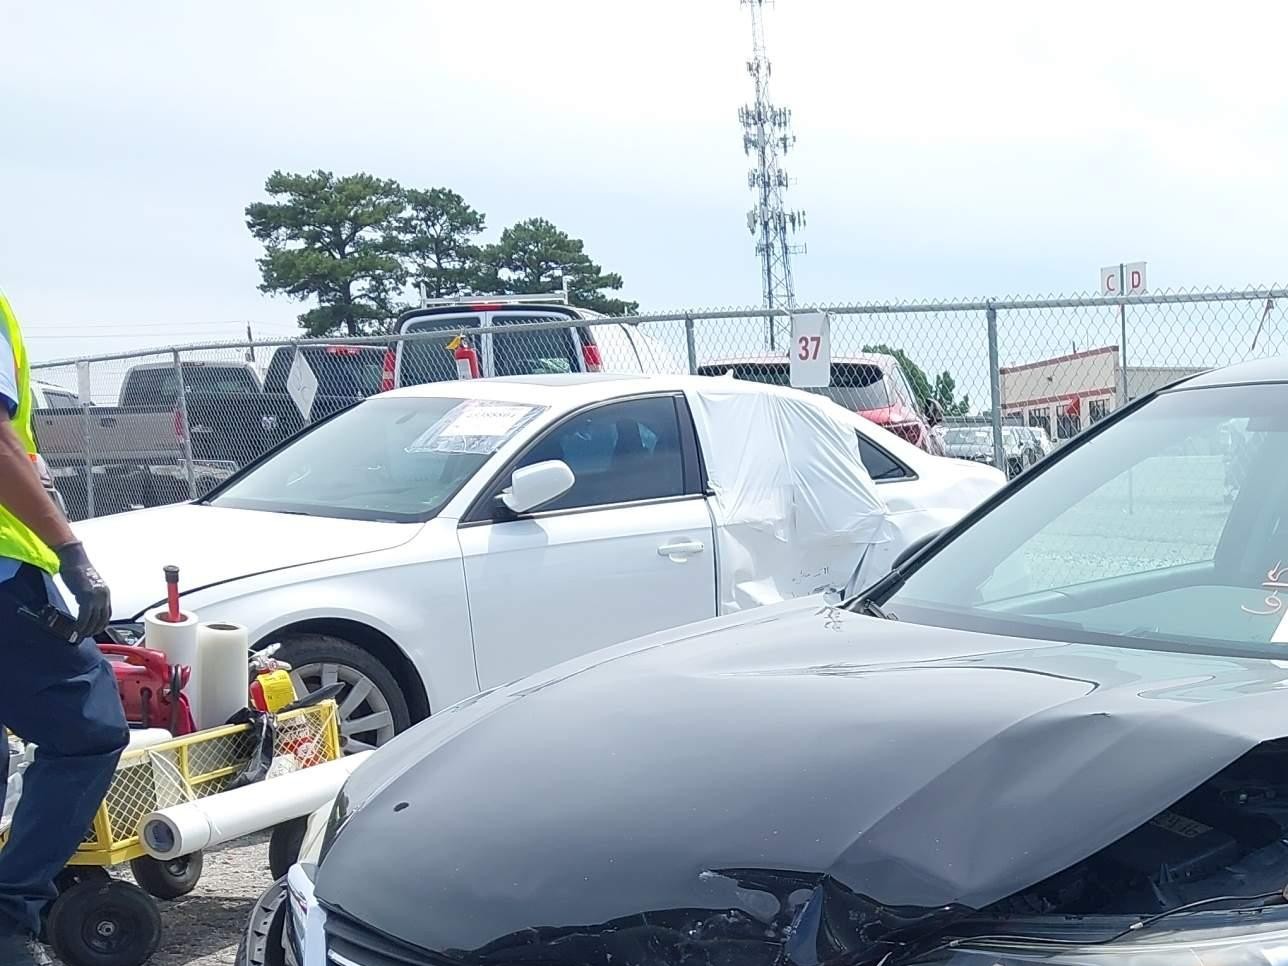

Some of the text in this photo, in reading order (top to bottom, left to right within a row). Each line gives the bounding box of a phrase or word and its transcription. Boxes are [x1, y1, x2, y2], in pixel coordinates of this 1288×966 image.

[1106, 273, 1116, 291] C
[1131, 271, 1141, 289] D
[798, 336, 821, 361] 37
